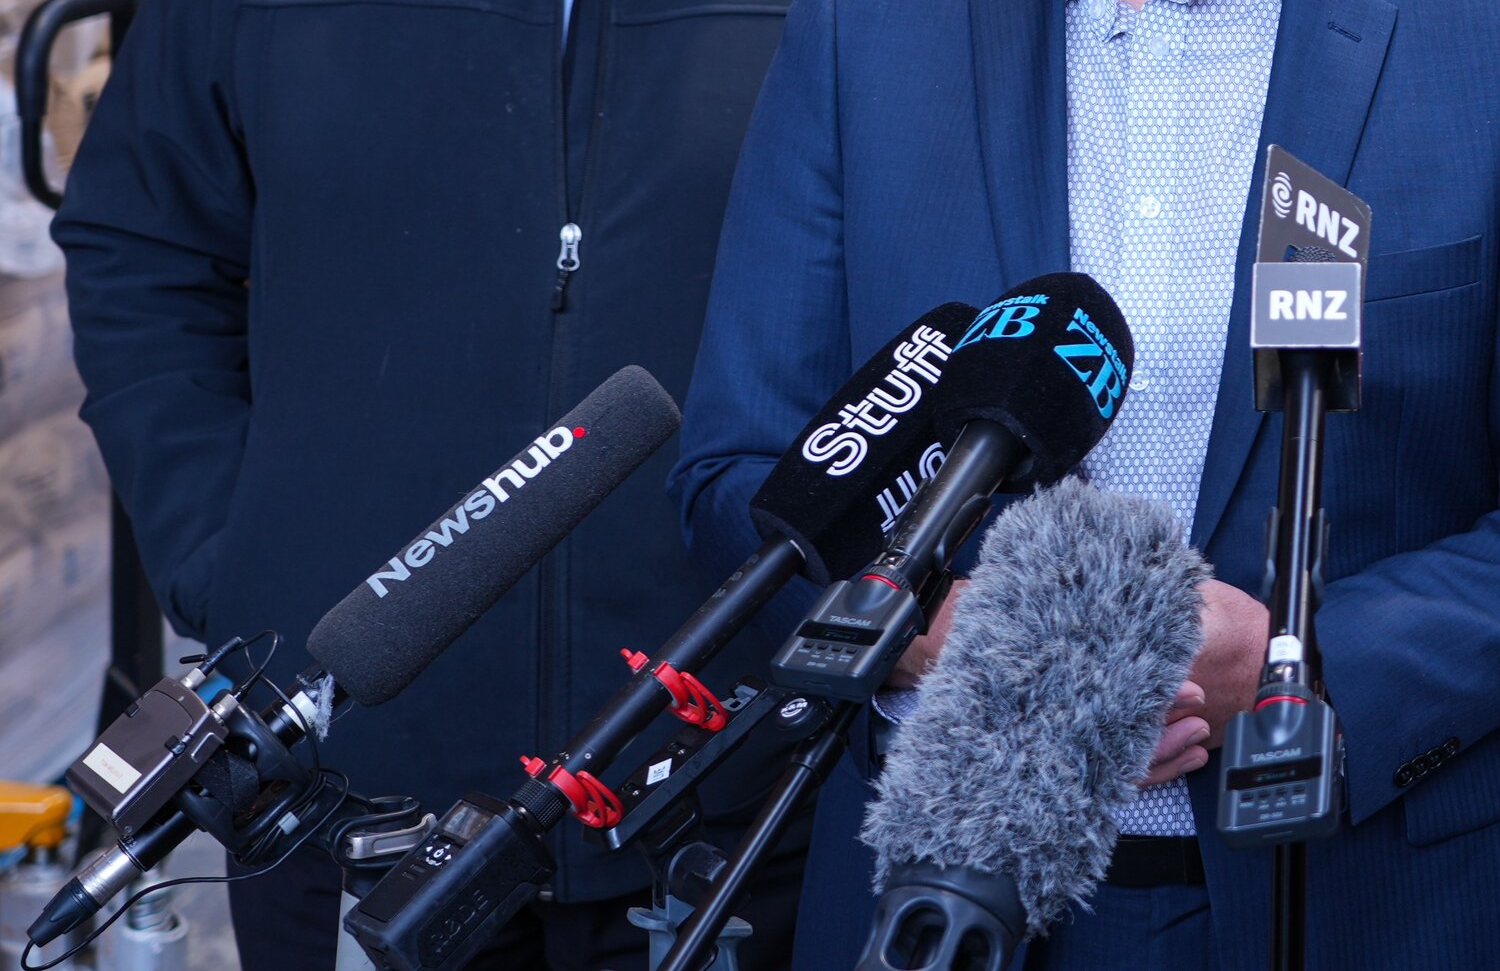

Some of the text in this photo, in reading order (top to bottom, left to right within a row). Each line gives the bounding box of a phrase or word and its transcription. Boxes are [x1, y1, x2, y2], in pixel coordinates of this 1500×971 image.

[1296, 189, 1360, 259] RNZ
[952, 305, 1041, 353] ZB
[1269, 290, 1348, 321] RNZ
[1053, 320, 1121, 420] ZB
[802, 324, 953, 476] Stuff
[829, 615, 872, 627] TASCAM
[1251, 747, 1301, 763] TASCAM
